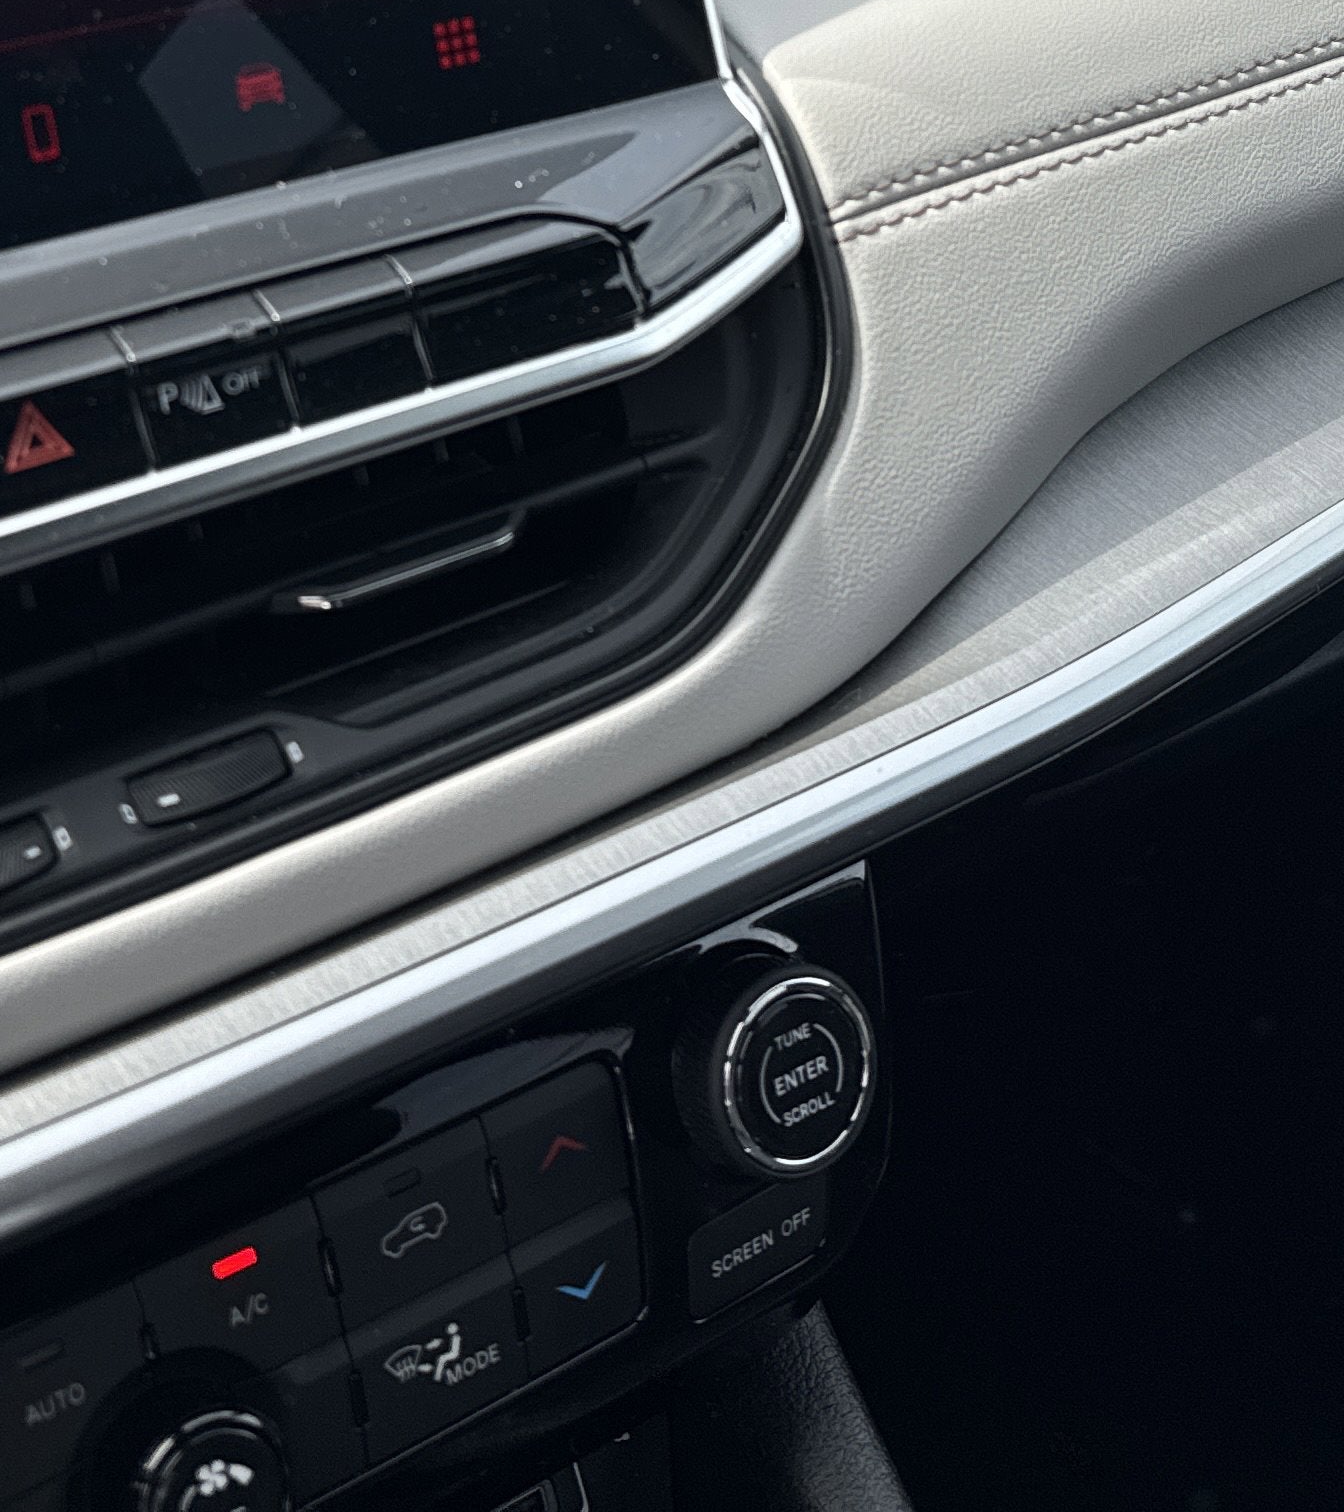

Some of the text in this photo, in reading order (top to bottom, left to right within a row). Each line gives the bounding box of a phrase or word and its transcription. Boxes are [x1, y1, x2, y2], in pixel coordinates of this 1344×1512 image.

[773, 1021, 813, 1051] TUNE
[773, 1055, 830, 1097] ENTER
[782, 1091, 837, 1128] SCROLL
[710, 1206, 811, 1279] SCREEN OFF
[229, 1292, 270, 1328] A/C
[444, 1342, 501, 1386] MODE
[24, 1381, 87, 1427] AUTO
